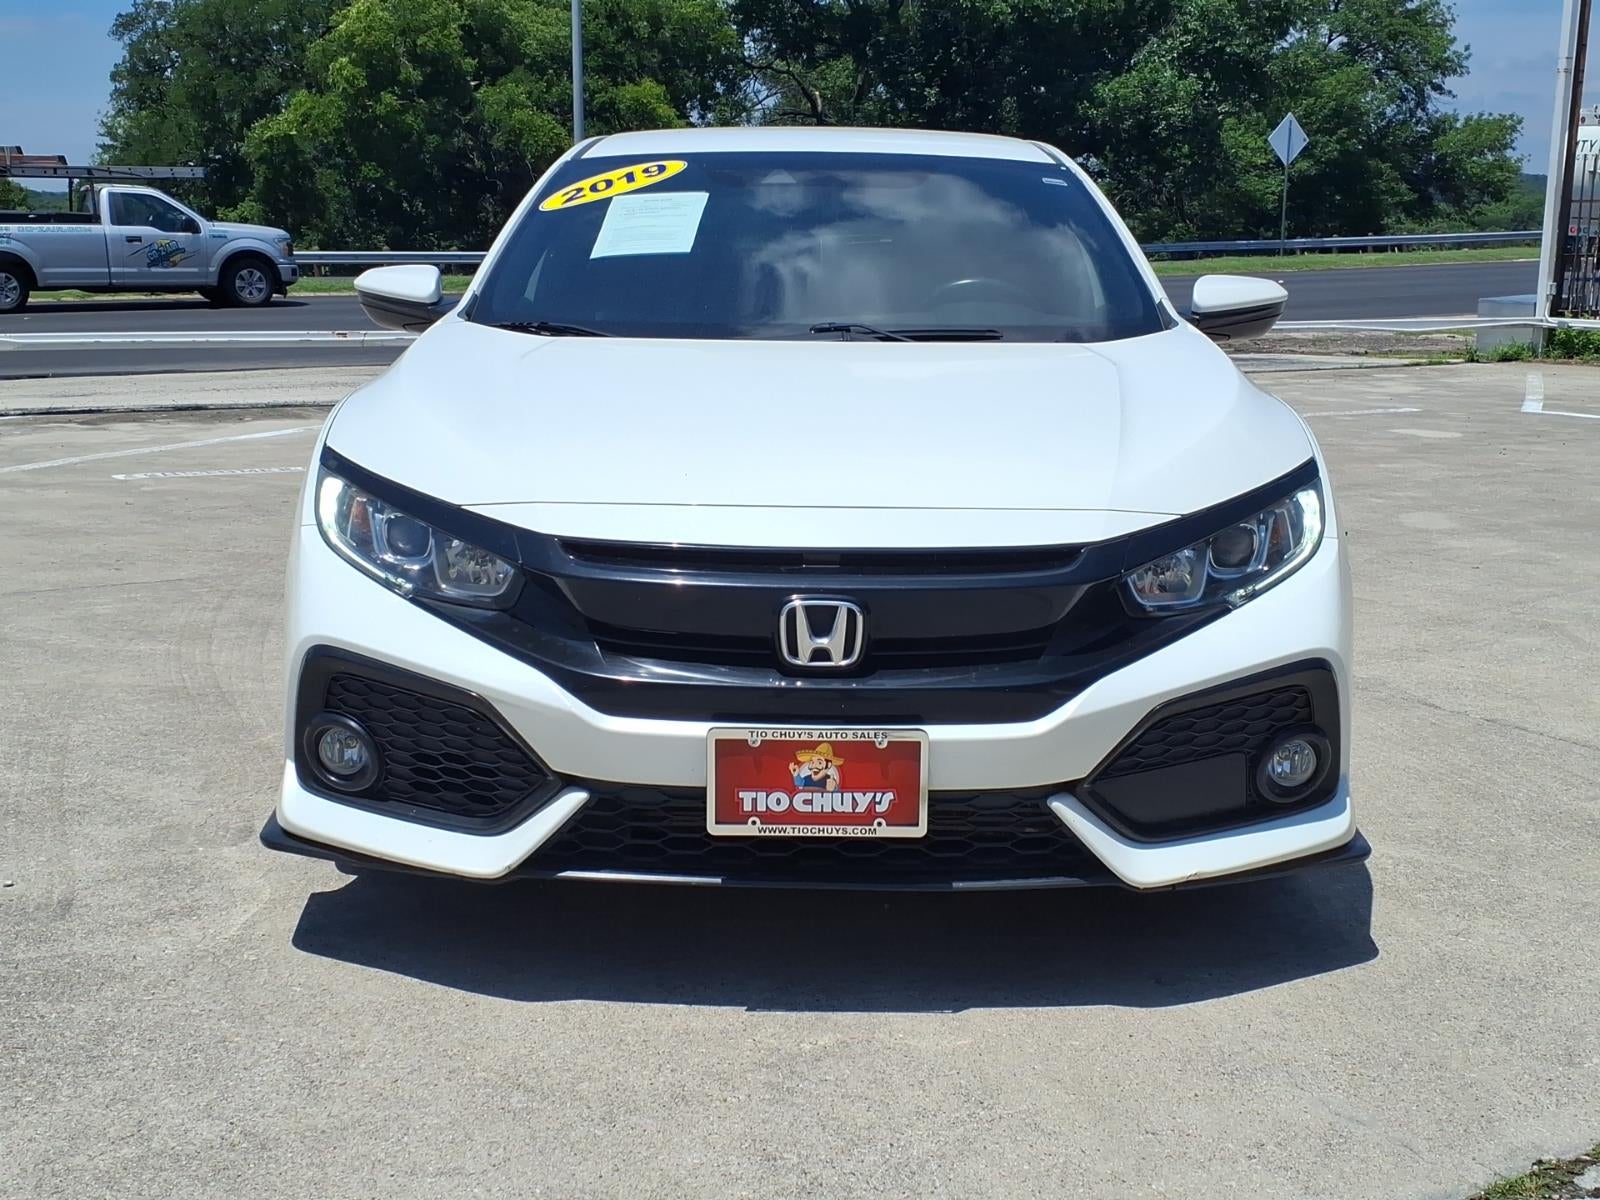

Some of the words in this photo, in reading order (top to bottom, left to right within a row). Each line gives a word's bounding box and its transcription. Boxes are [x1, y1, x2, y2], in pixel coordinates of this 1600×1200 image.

[561, 164, 667, 205] 2019
[748, 730, 768, 738] TIO
[771, 730, 814, 739] CHUY'S
[817, 731, 849, 739] AUTO
[851, 731, 888, 740] SALES
[757, 826, 878, 836] WWW.TIOCHUYS.COM
